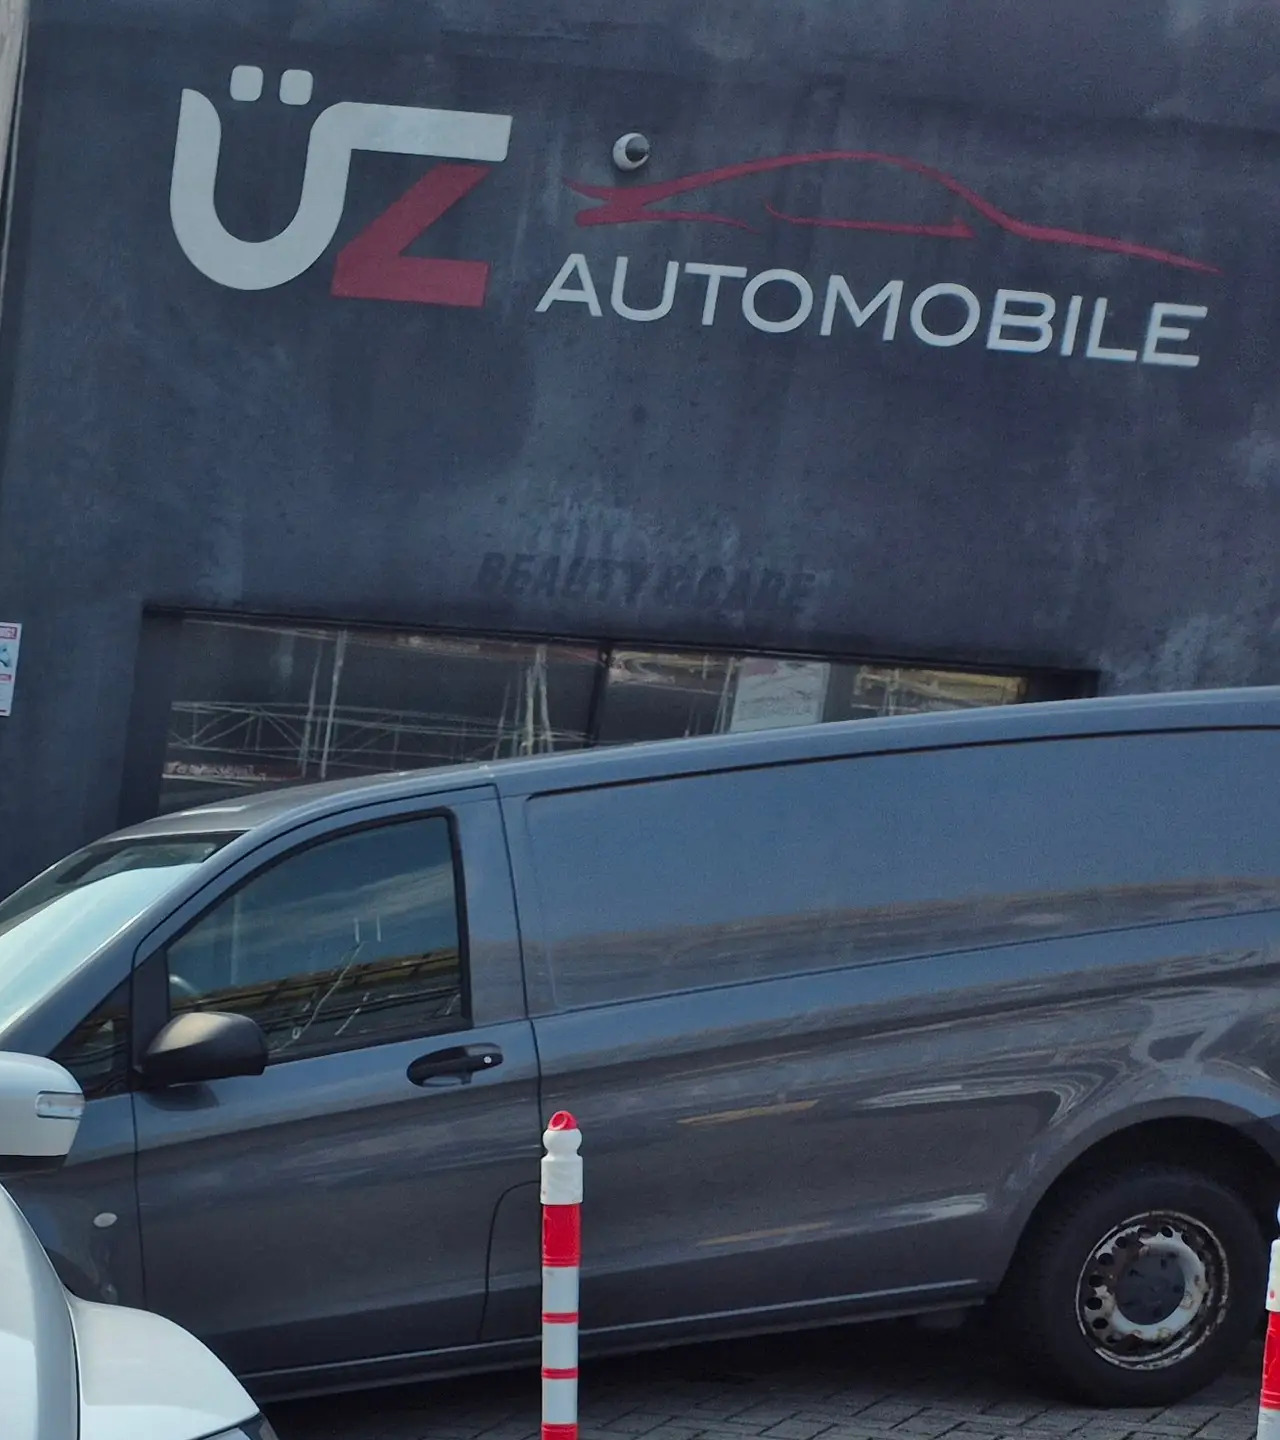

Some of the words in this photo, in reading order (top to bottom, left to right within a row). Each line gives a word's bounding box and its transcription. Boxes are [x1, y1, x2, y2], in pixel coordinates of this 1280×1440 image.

[169, 64, 513, 308] ÜZ
[535, 251, 1209, 367] AUTOMOBILE
[476, 551, 649, 606] BEAUTY
